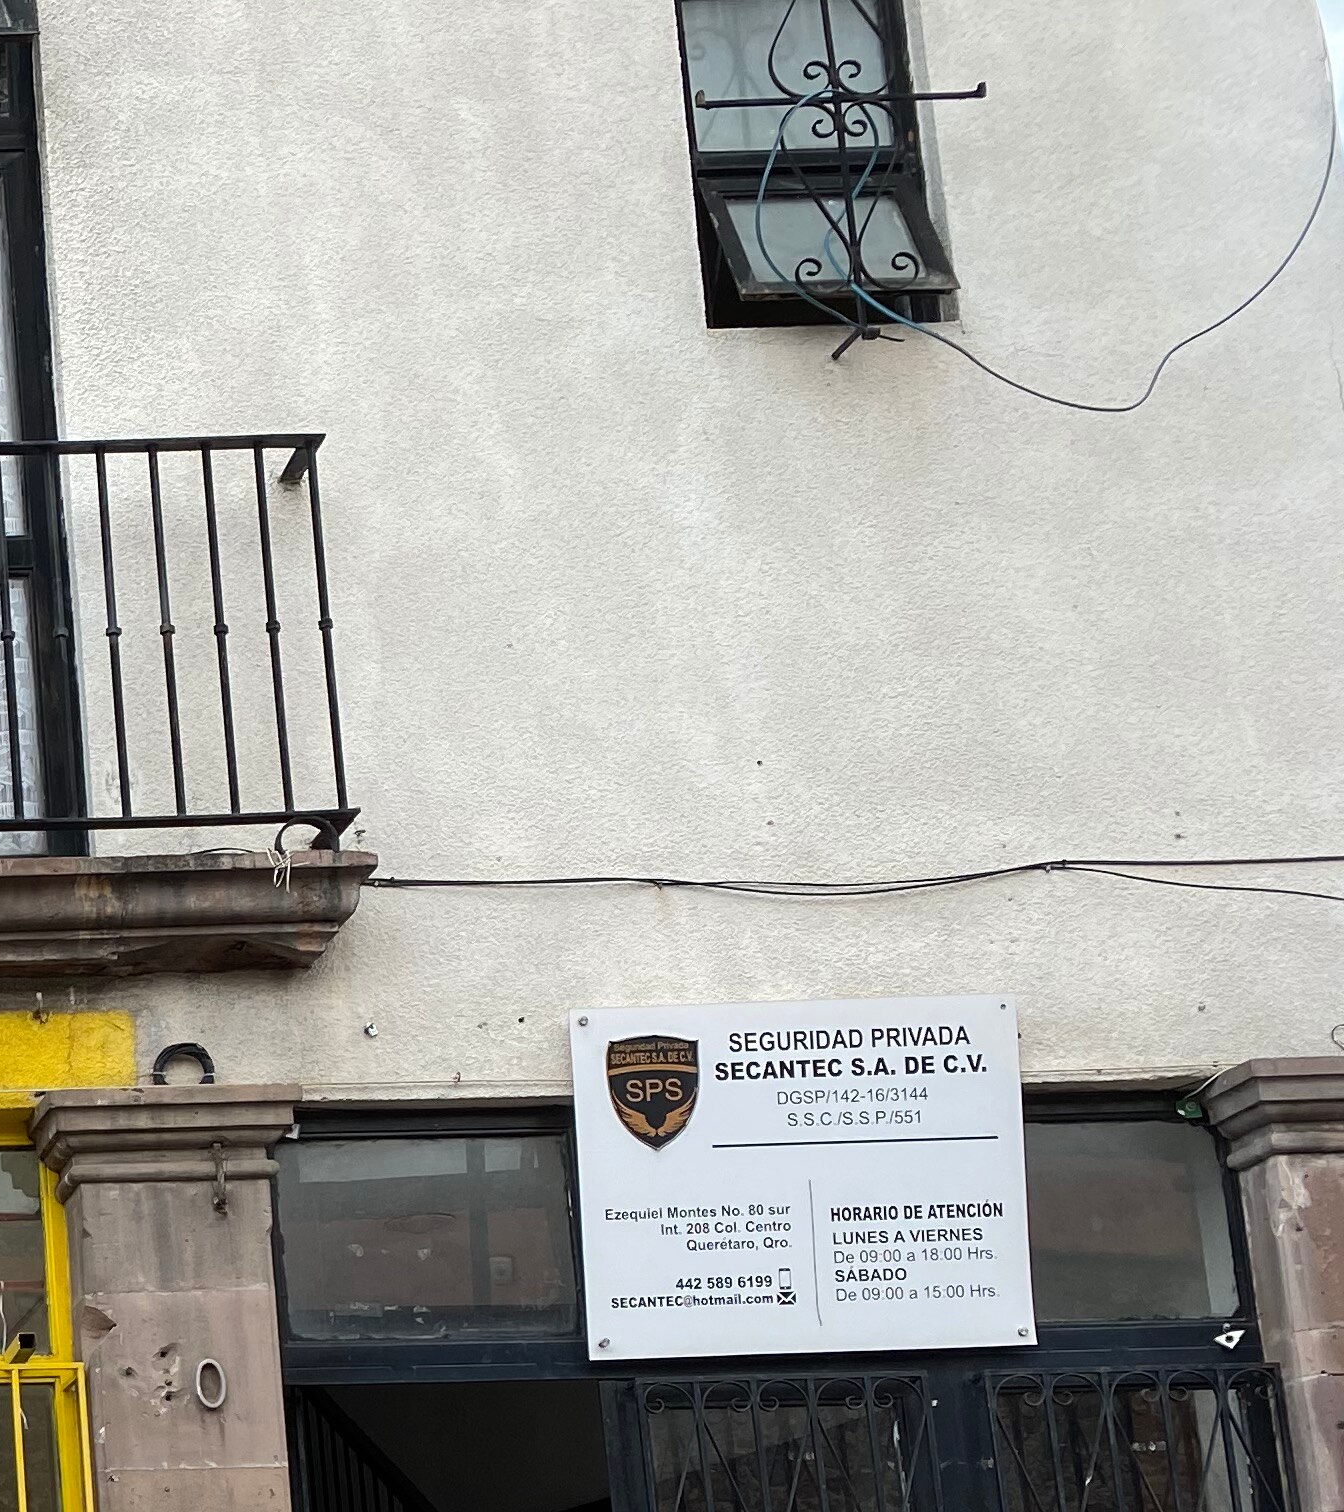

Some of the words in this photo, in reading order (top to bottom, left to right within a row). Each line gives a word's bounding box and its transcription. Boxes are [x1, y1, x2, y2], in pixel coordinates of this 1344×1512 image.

[728, 1029, 864, 1053] SEGURIDAD
[870, 1025, 971, 1048] PRIVADA
[611, 1053, 651, 1064] SECANTEC
[714, 1059, 843, 1081] SECANTEC
[851, 1057, 896, 1077] S.A.
[904, 1056, 936, 1075] DE
[943, 1053, 988, 1073] C.V.
[625, 1078, 683, 1102] SPS
[776, 1087, 929, 1105] DGSP/142-16/3144
[787, 1109, 922, 1127] S.S.C./S.S.P./551
[605, 1208, 663, 1222] Ezequiel
[667, 1206, 717, 1219] Montes
[721, 1205, 745, 1217] No.
[748, 1204, 764, 1216] 80
[768, 1205, 791, 1216] sur
[830, 1206, 899, 1222] HORARIO
[903, 1205, 923, 1219] DE
[927, 1199, 1004, 1219] ATENCIÓN
[660, 1224, 682, 1236] Int.
[686, 1222, 710, 1234] 208
[714, 1221, 741, 1233] Col.
[745, 1220, 792, 1233] Centro
[832, 1230, 889, 1245] LUNES
[893, 1230, 906, 1243] A
[909, 1228, 983, 1243] VIERNES
[686, 1237, 759, 1252] Querétaro,
[763, 1237, 793, 1249] Qro.
[833, 1250, 855, 1263] De
[859, 1249, 902, 1263] 09:00
[906, 1251, 916, 1262] a
[921, 1248, 962, 1261] 18:00
[967, 1246, 998, 1260] Hrs.
[675, 1278, 702, 1290] 442
[706, 1276, 733, 1289] 589
[737, 1275, 773, 1288] 6199
[834, 1265, 908, 1283] SÁBADO
[611, 1293, 774, 1309] SECANTEC@hotmail.com
[836, 1288, 857, 1301] De
[861, 1286, 904, 1301] 09:00
[909, 1289, 918, 1299] a
[924, 1285, 965, 1299] 15:00
[969, 1284, 1000, 1298] Hrs.
